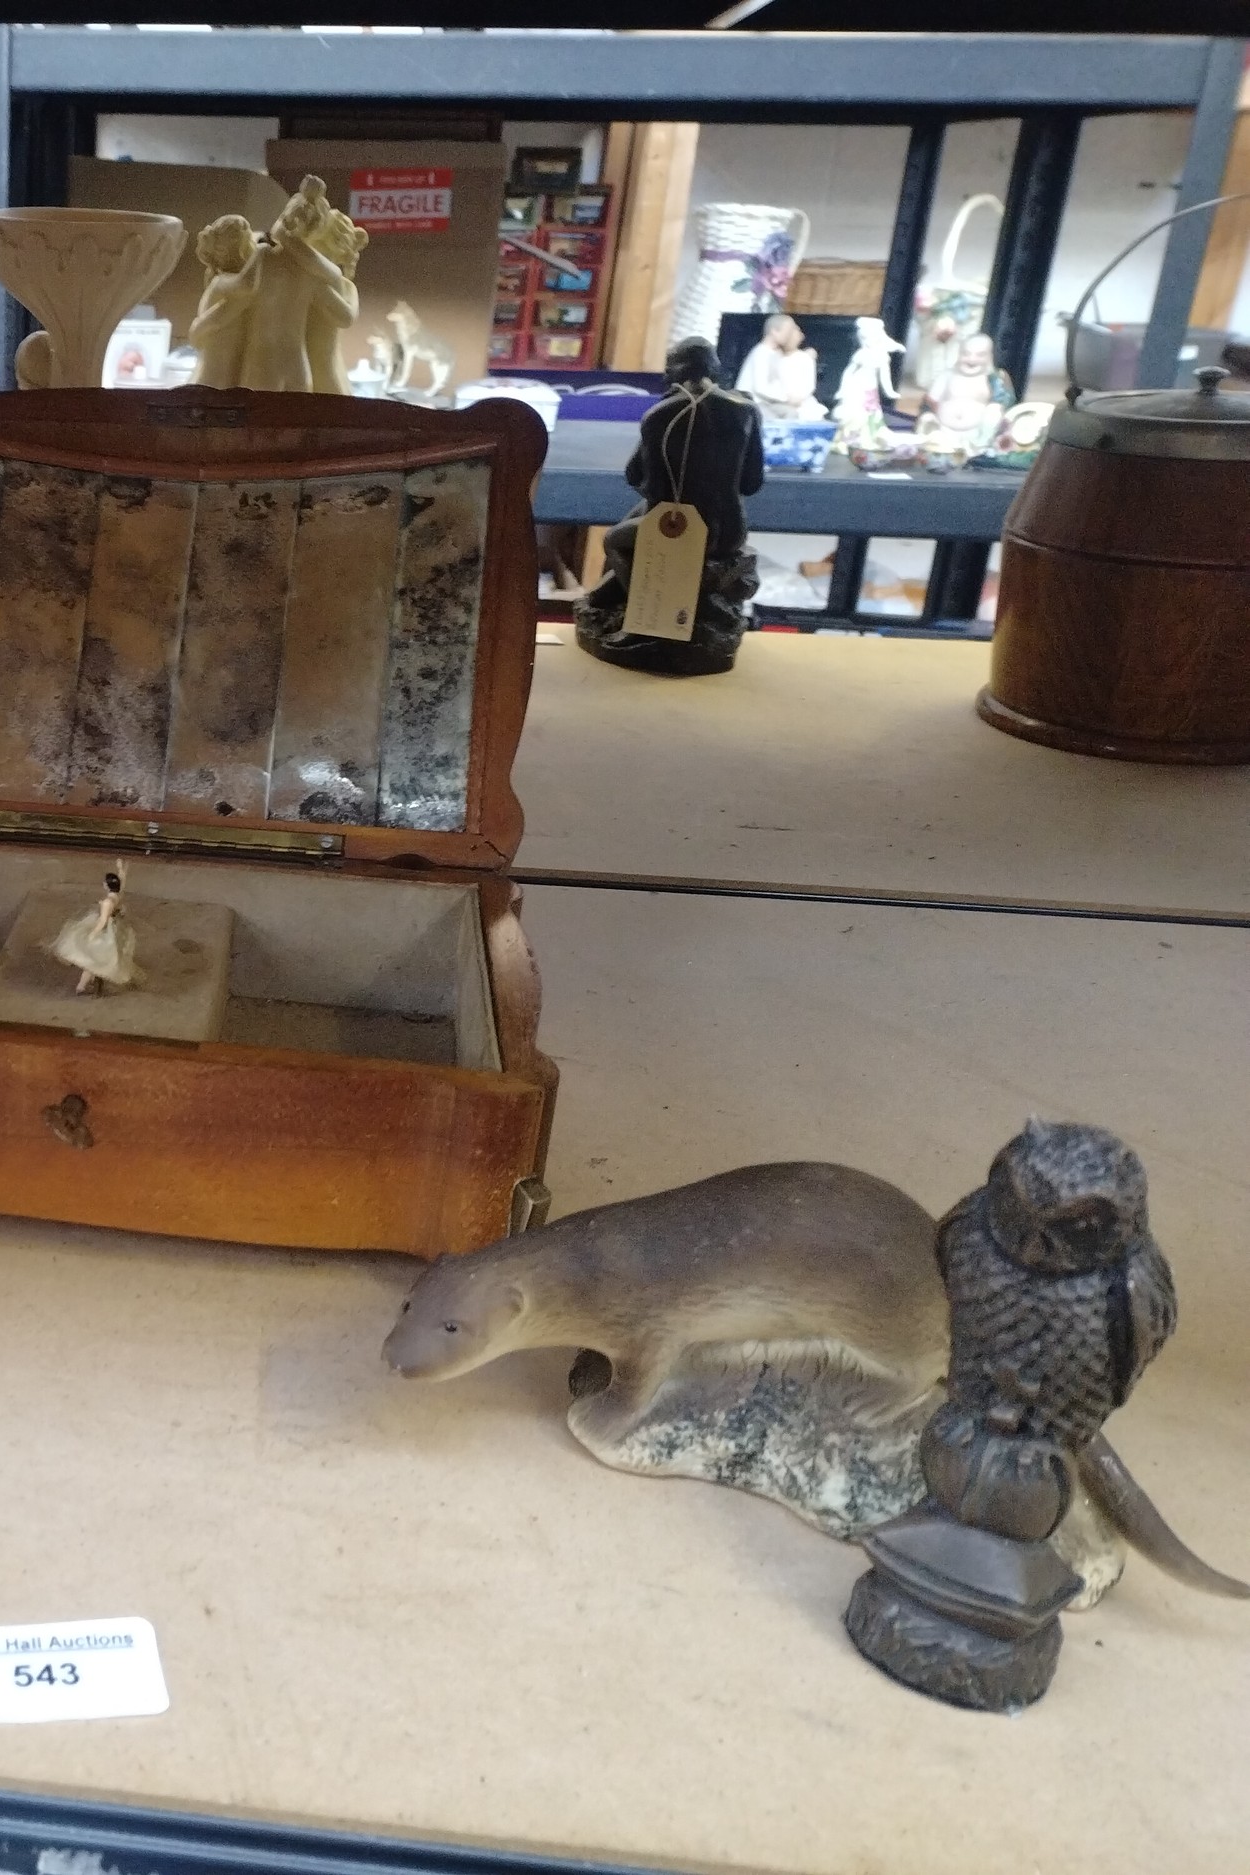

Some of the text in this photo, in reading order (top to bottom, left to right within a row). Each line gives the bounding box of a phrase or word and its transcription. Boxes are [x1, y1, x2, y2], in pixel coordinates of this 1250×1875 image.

[358, 193, 443, 213] FRAGILE
[6, 1636, 42, 1652] Hall
[49, 1633, 134, 1649] Auctions
[13, 1662, 81, 1687] 543
